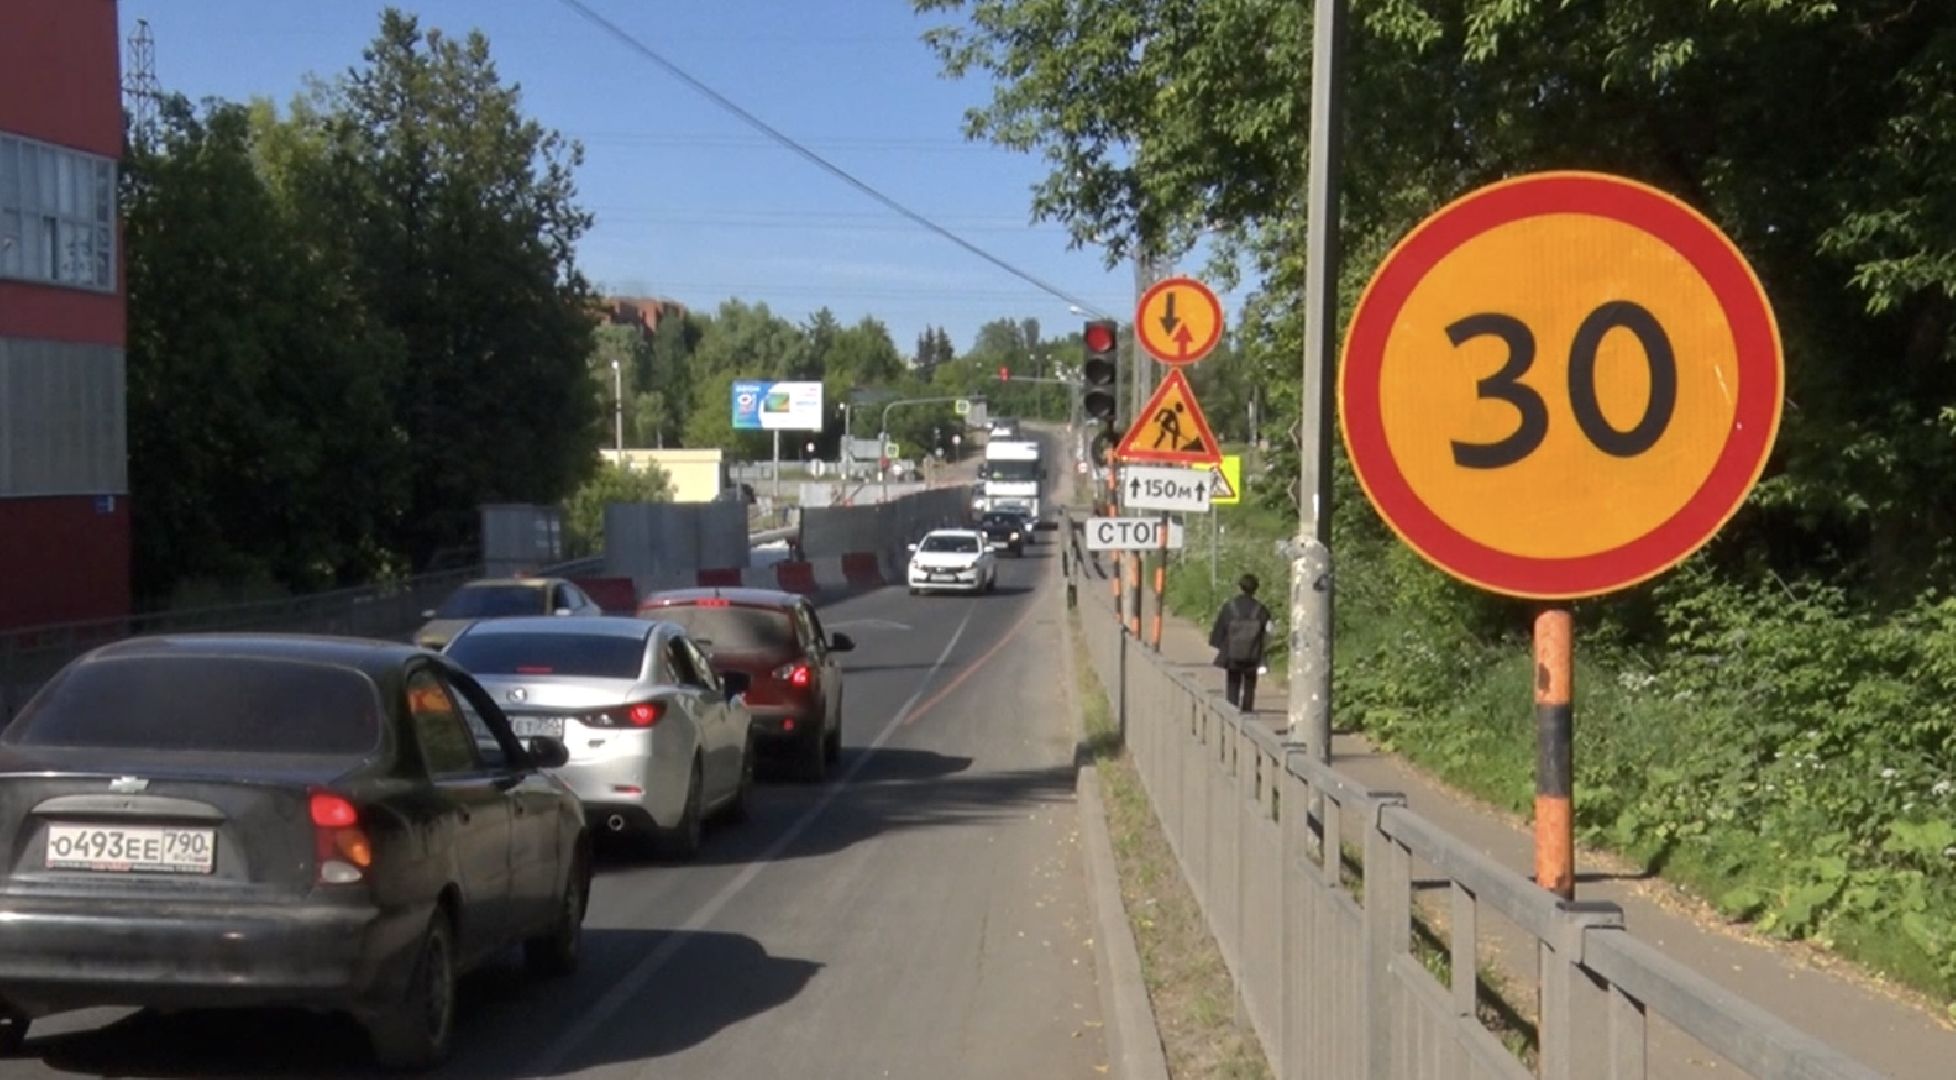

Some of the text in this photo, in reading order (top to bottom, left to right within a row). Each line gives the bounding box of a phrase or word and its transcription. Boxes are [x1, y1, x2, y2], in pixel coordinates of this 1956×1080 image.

[1445, 299, 1678, 470] 30
[1144, 479, 1192, 498] 150м
[165, 832, 204, 854] 790
